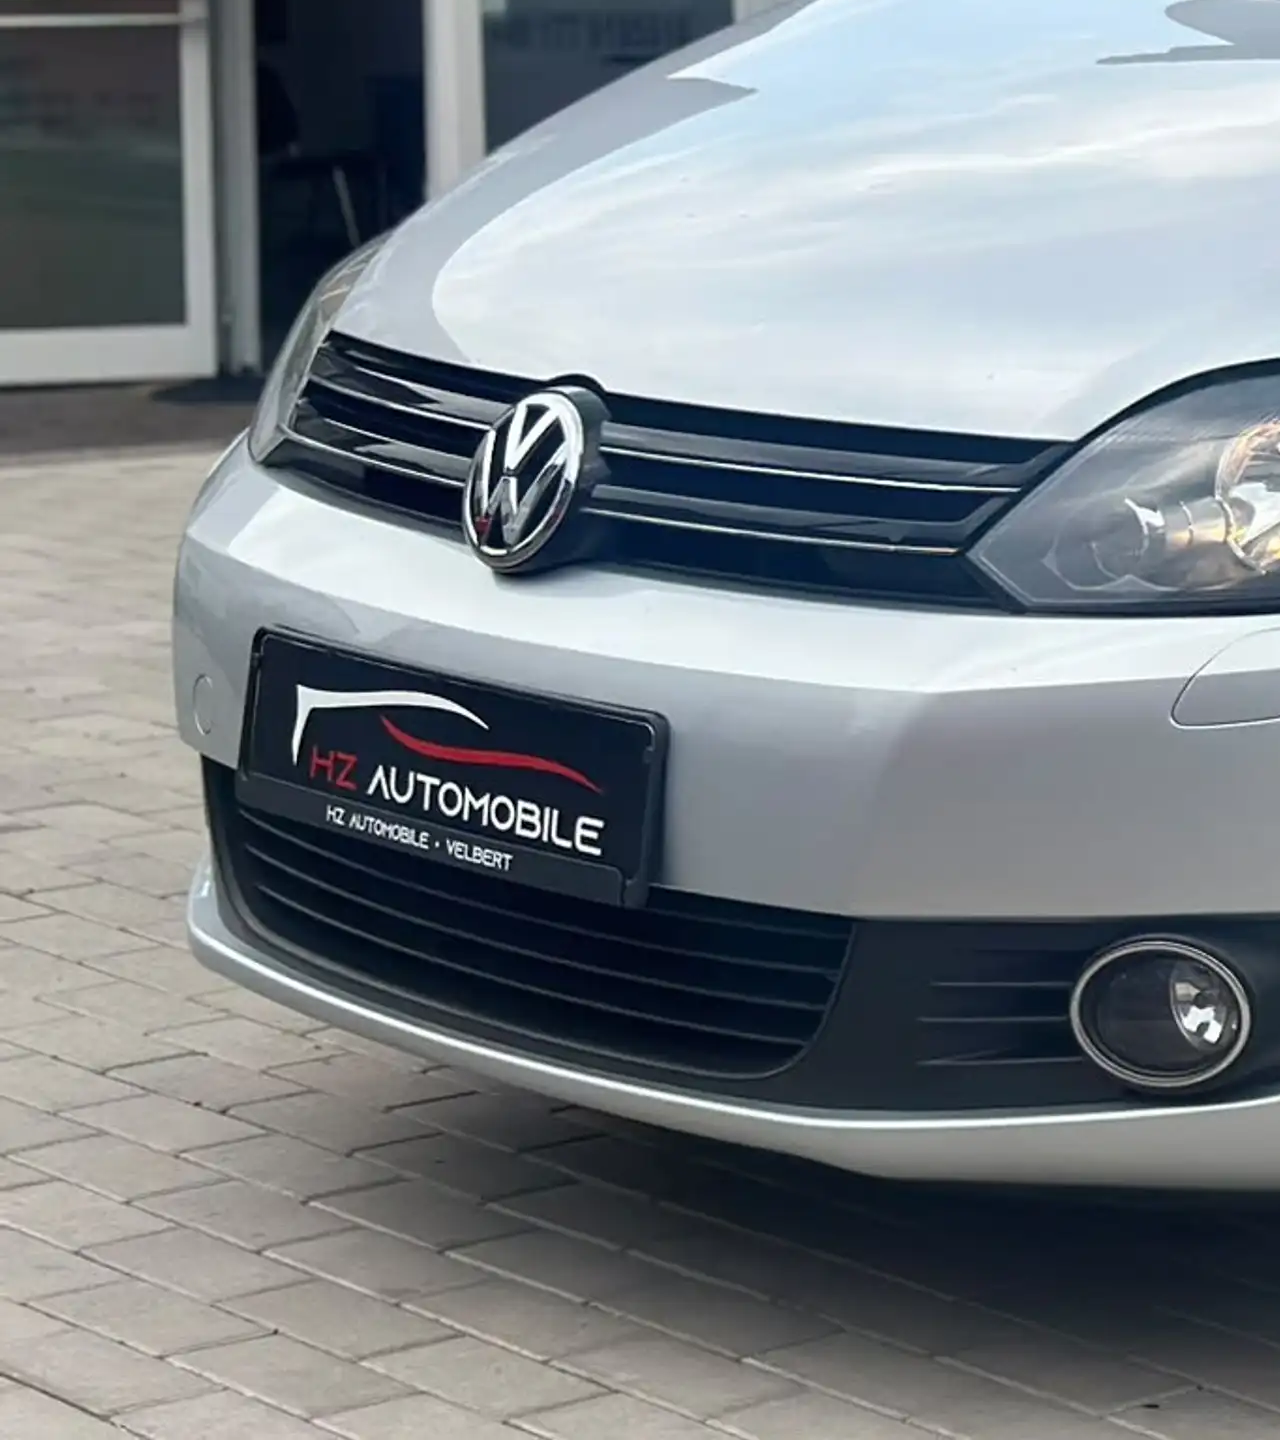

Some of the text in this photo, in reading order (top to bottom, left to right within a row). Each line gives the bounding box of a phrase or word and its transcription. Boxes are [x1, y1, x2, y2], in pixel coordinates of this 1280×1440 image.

[310, 744, 605, 856] HZ AUTOMOBILE
[326, 805, 513, 872] HZ AUTOMOBILE VELBERT
